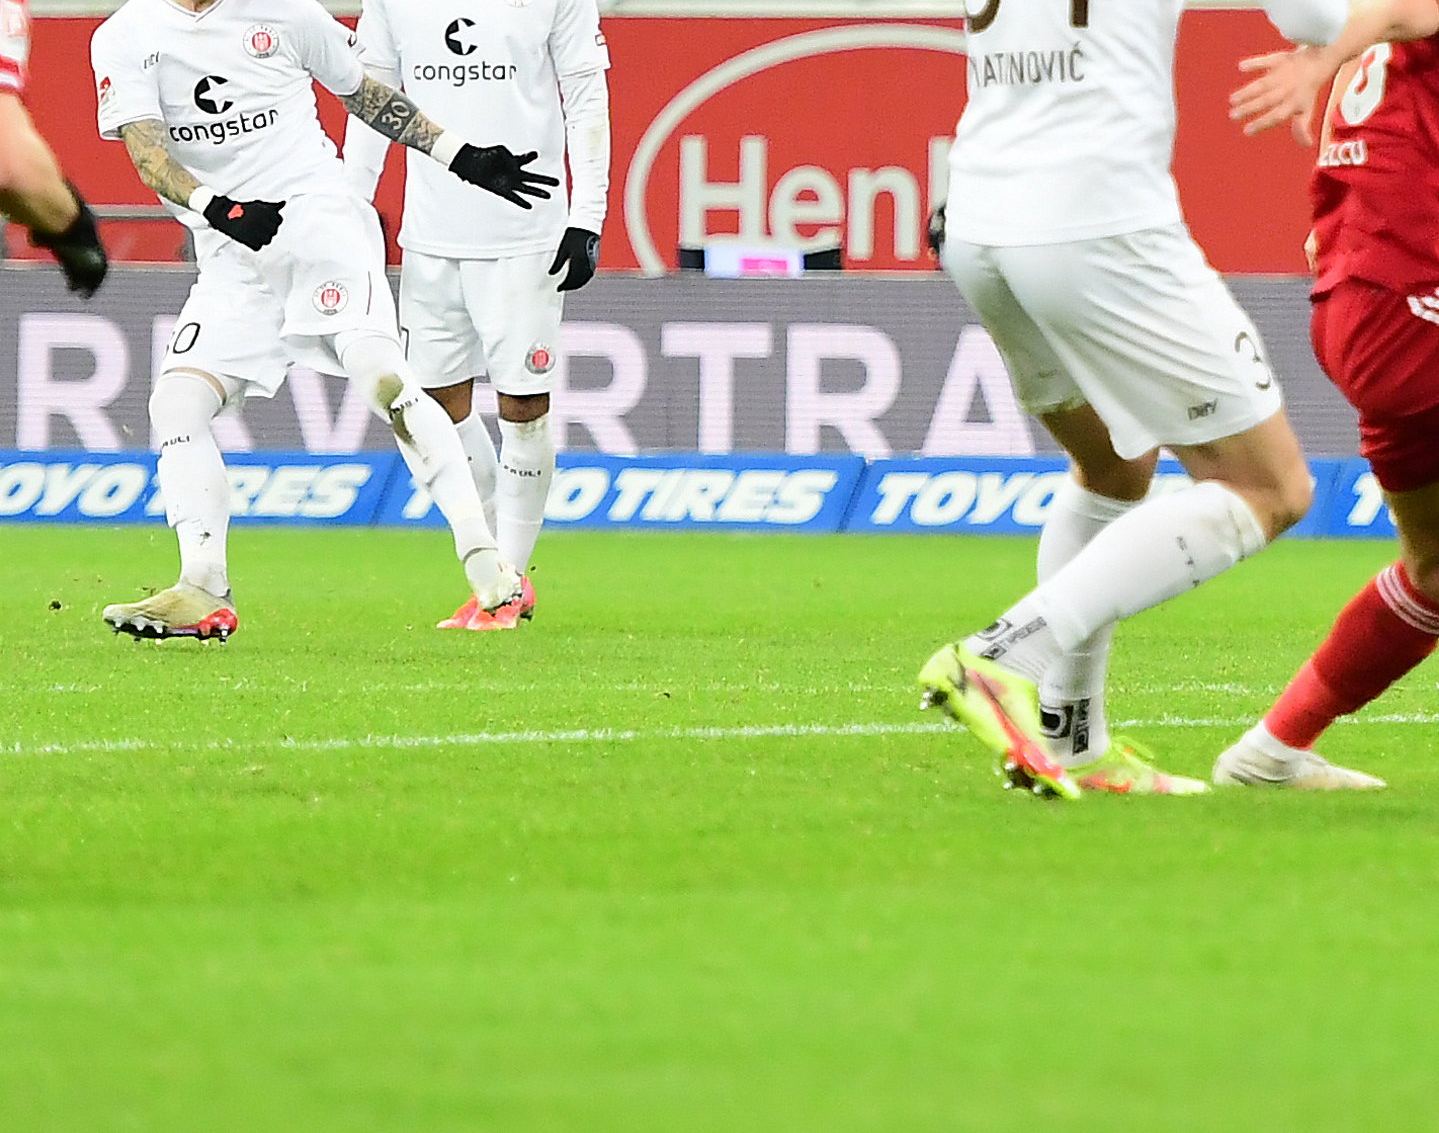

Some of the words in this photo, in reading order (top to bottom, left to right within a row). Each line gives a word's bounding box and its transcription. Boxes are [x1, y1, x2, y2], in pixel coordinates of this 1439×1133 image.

[413, 60, 517, 88] congstar
[169, 108, 279, 146] congstar
[381, 101, 410, 130] 30
[607, 466, 838, 526] TIRES
